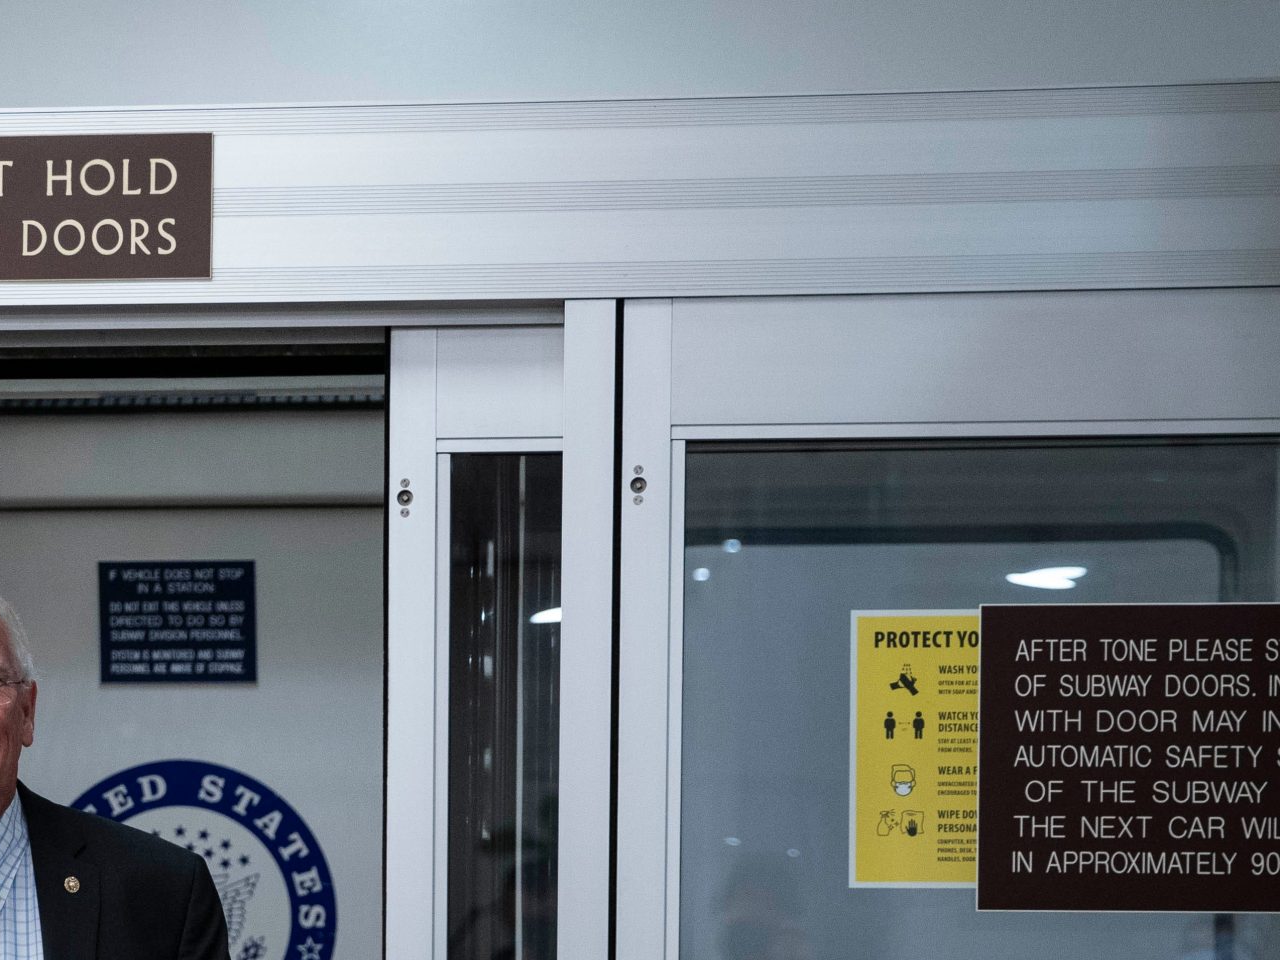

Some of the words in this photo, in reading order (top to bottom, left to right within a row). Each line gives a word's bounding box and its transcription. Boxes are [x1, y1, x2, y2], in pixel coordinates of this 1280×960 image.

[46, 158, 178, 197] HOLD
[21, 217, 177, 257] DOORS
[122, 568, 161, 581] VEHICLE
[163, 568, 192, 581] DOES
[194, 568, 214, 581] NOT
[218, 568, 245, 581] STOP
[137, 582, 149, 594] IN
[152, 582, 163, 594] A
[110, 615, 163, 628] DIRECTED
[167, 615, 183, 628] TO
[186, 615, 205, 628] DO
[208, 615, 225, 628] SO
[228, 615, 245, 628] BY
[111, 629, 146, 641] SUBWAY
[874, 631, 953, 648] PROTECT
[956, 631, 979, 648] YO
[1015, 639, 1087, 662] AFTER
[1100, 639, 1158, 662] TONE
[1169, 638, 1253, 662] PLEASE
[938, 665, 964, 674] WASH
[1014, 674, 1046, 697] OF
[1059, 674, 1152, 697] SUBWAY
[1165, 674, 1257, 697] DOORS.
[938, 711, 968, 720] WATCH
[1014, 709, 1081, 732] WITH
[1096, 709, 1177, 732] DOOR
[1192, 709, 1248, 732] MAY
[1262, 709, 1280, 732] IN
[1014, 745, 1152, 768] AUTOMATIC
[1165, 745, 1263, 768] SAFETY
[938, 766, 963, 775] WEAR
[965, 766, 971, 775] A
[1025, 780, 1063, 804] OF
[1081, 780, 1135, 804] THE
[1152, 780, 1268, 804] SUBWAY
[938, 810, 960, 819] WIPE
[1013, 816, 1066, 840] THE
[1081, 816, 1152, 840] NEXT
[1168, 816, 1226, 840] CAR
[1241, 816, 1280, 840] WIL
[198, 774, 326, 929] STATES
[1012, 851, 1033, 875] IN
[1045, 851, 1238, 875] APPROXIMATELY
[1251, 851, 1280, 875] 90
